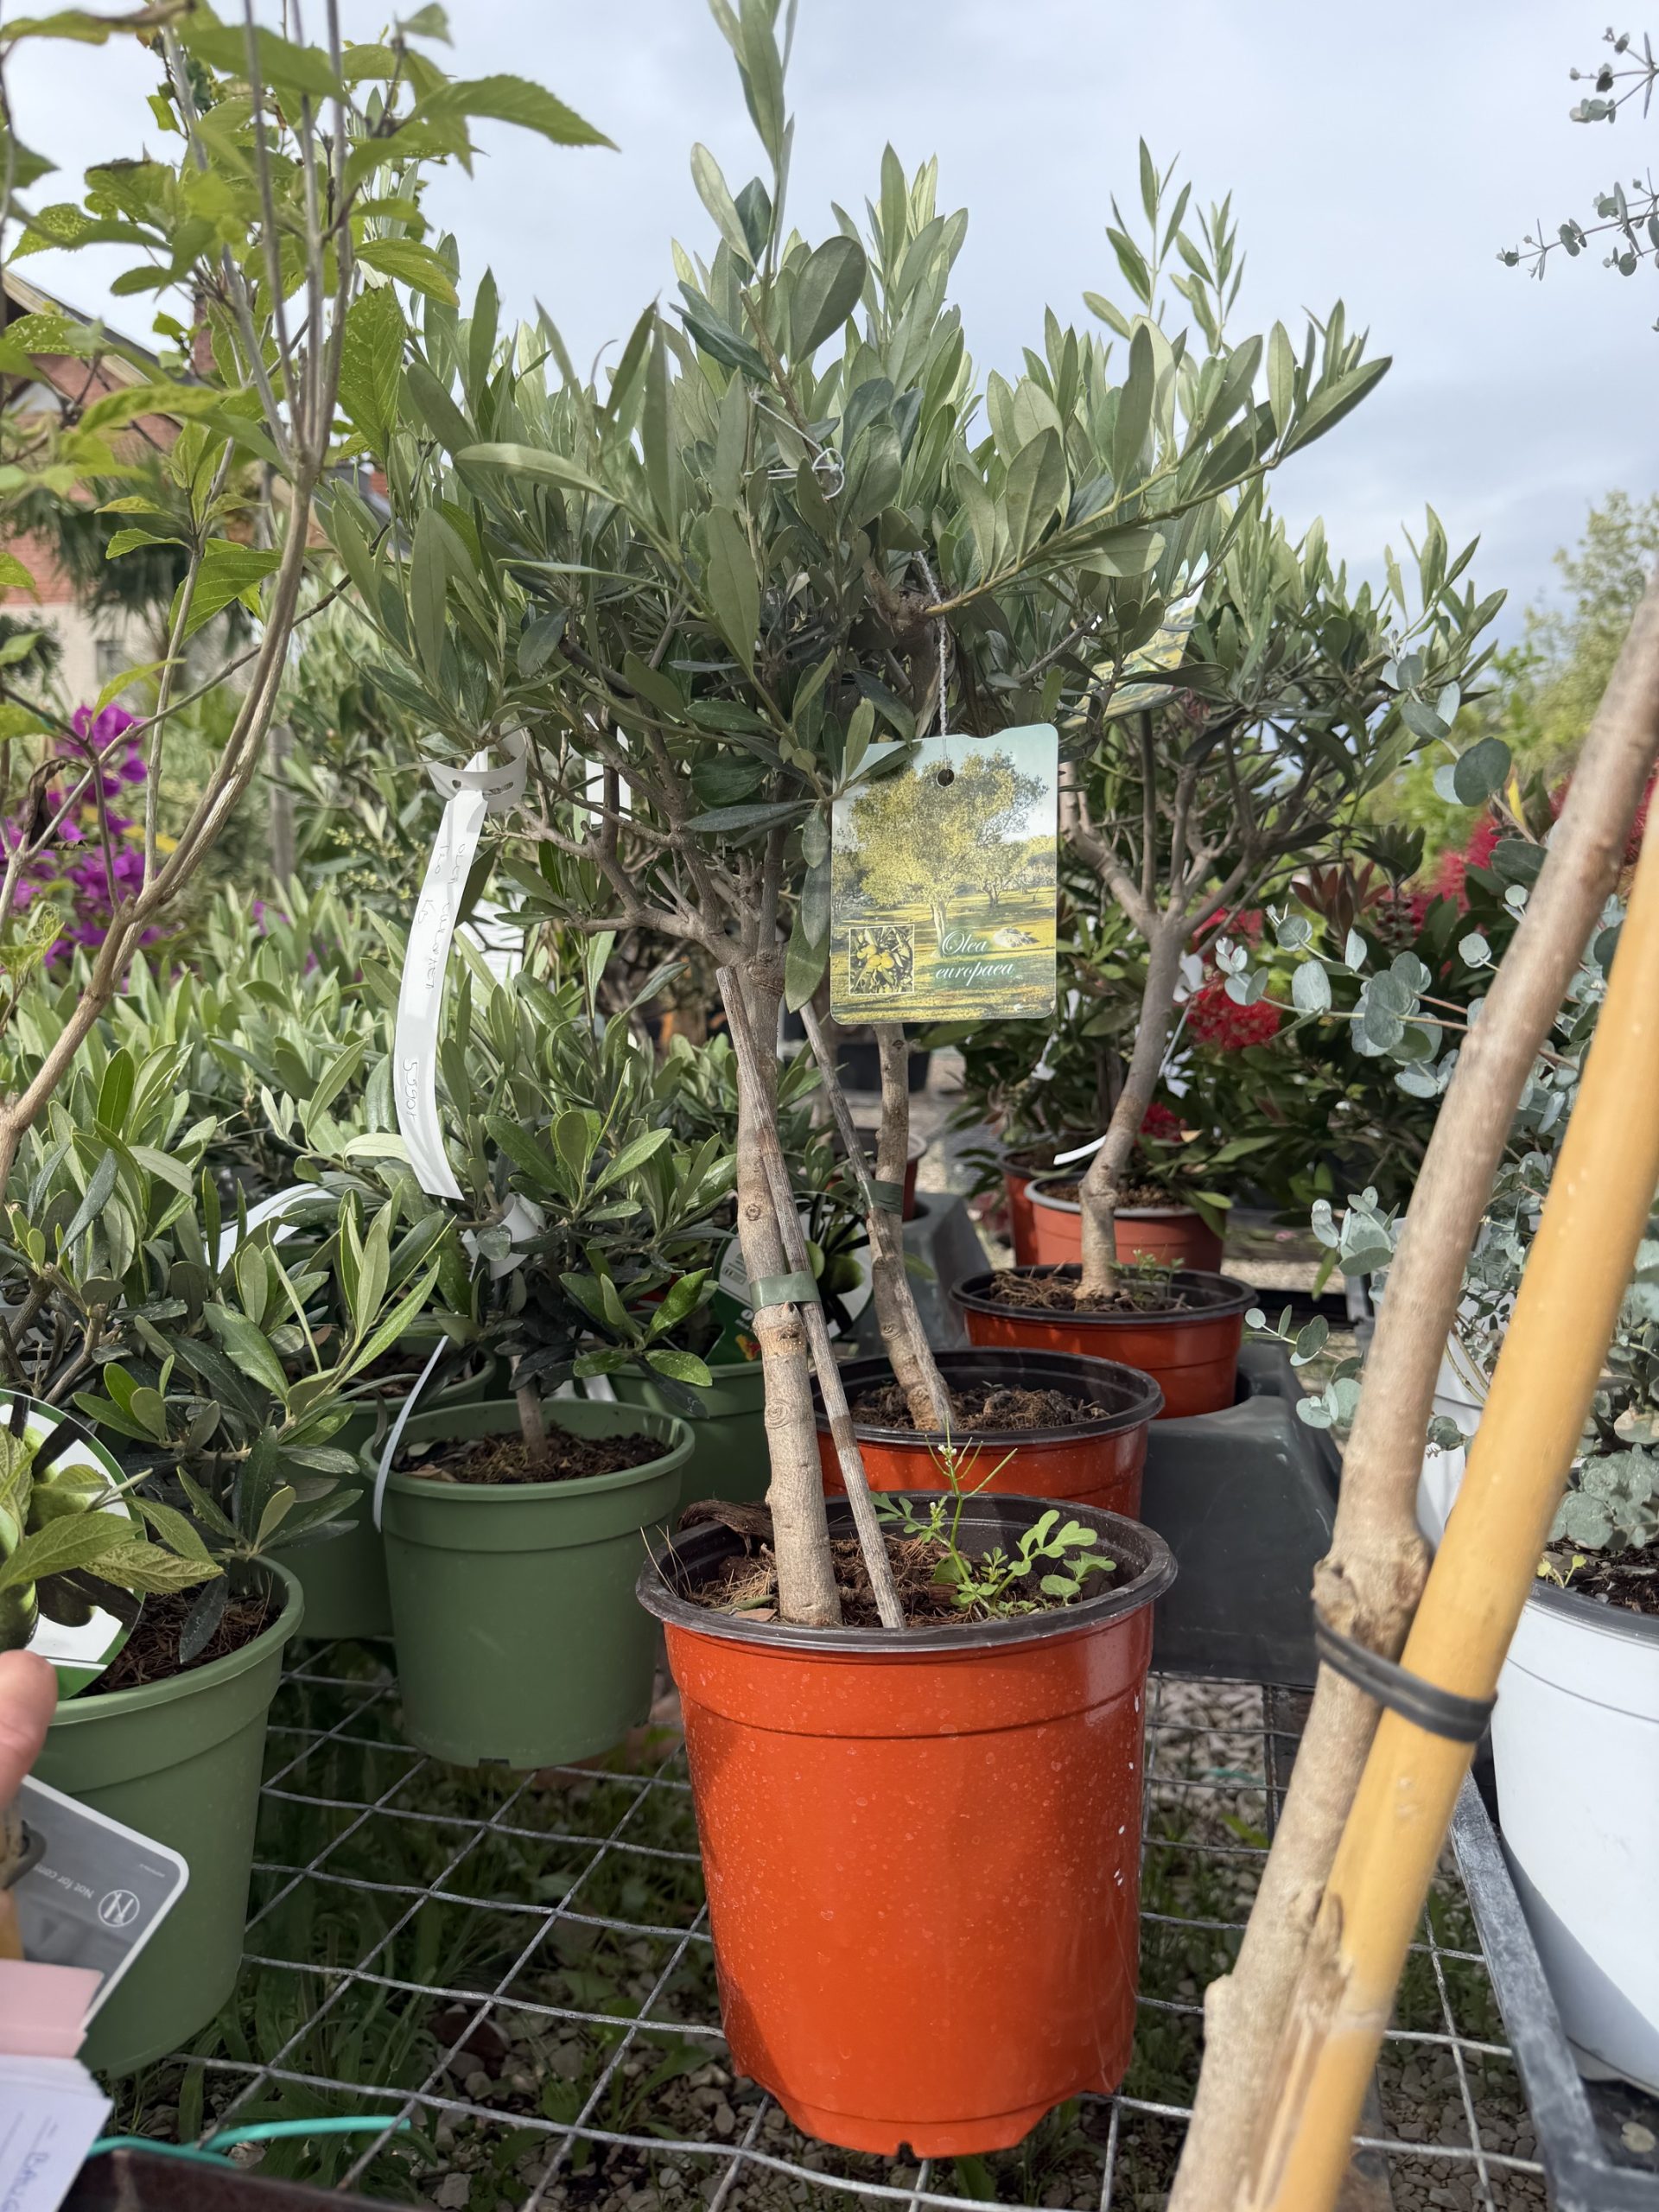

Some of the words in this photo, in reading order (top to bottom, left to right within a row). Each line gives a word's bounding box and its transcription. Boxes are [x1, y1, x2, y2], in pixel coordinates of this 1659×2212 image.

[942, 930, 987, 955] Olea
[936, 962, 1014, 986] europaea
[57, 1875, 73, 1890] for
[74, 1882, 94, 1899] Not
